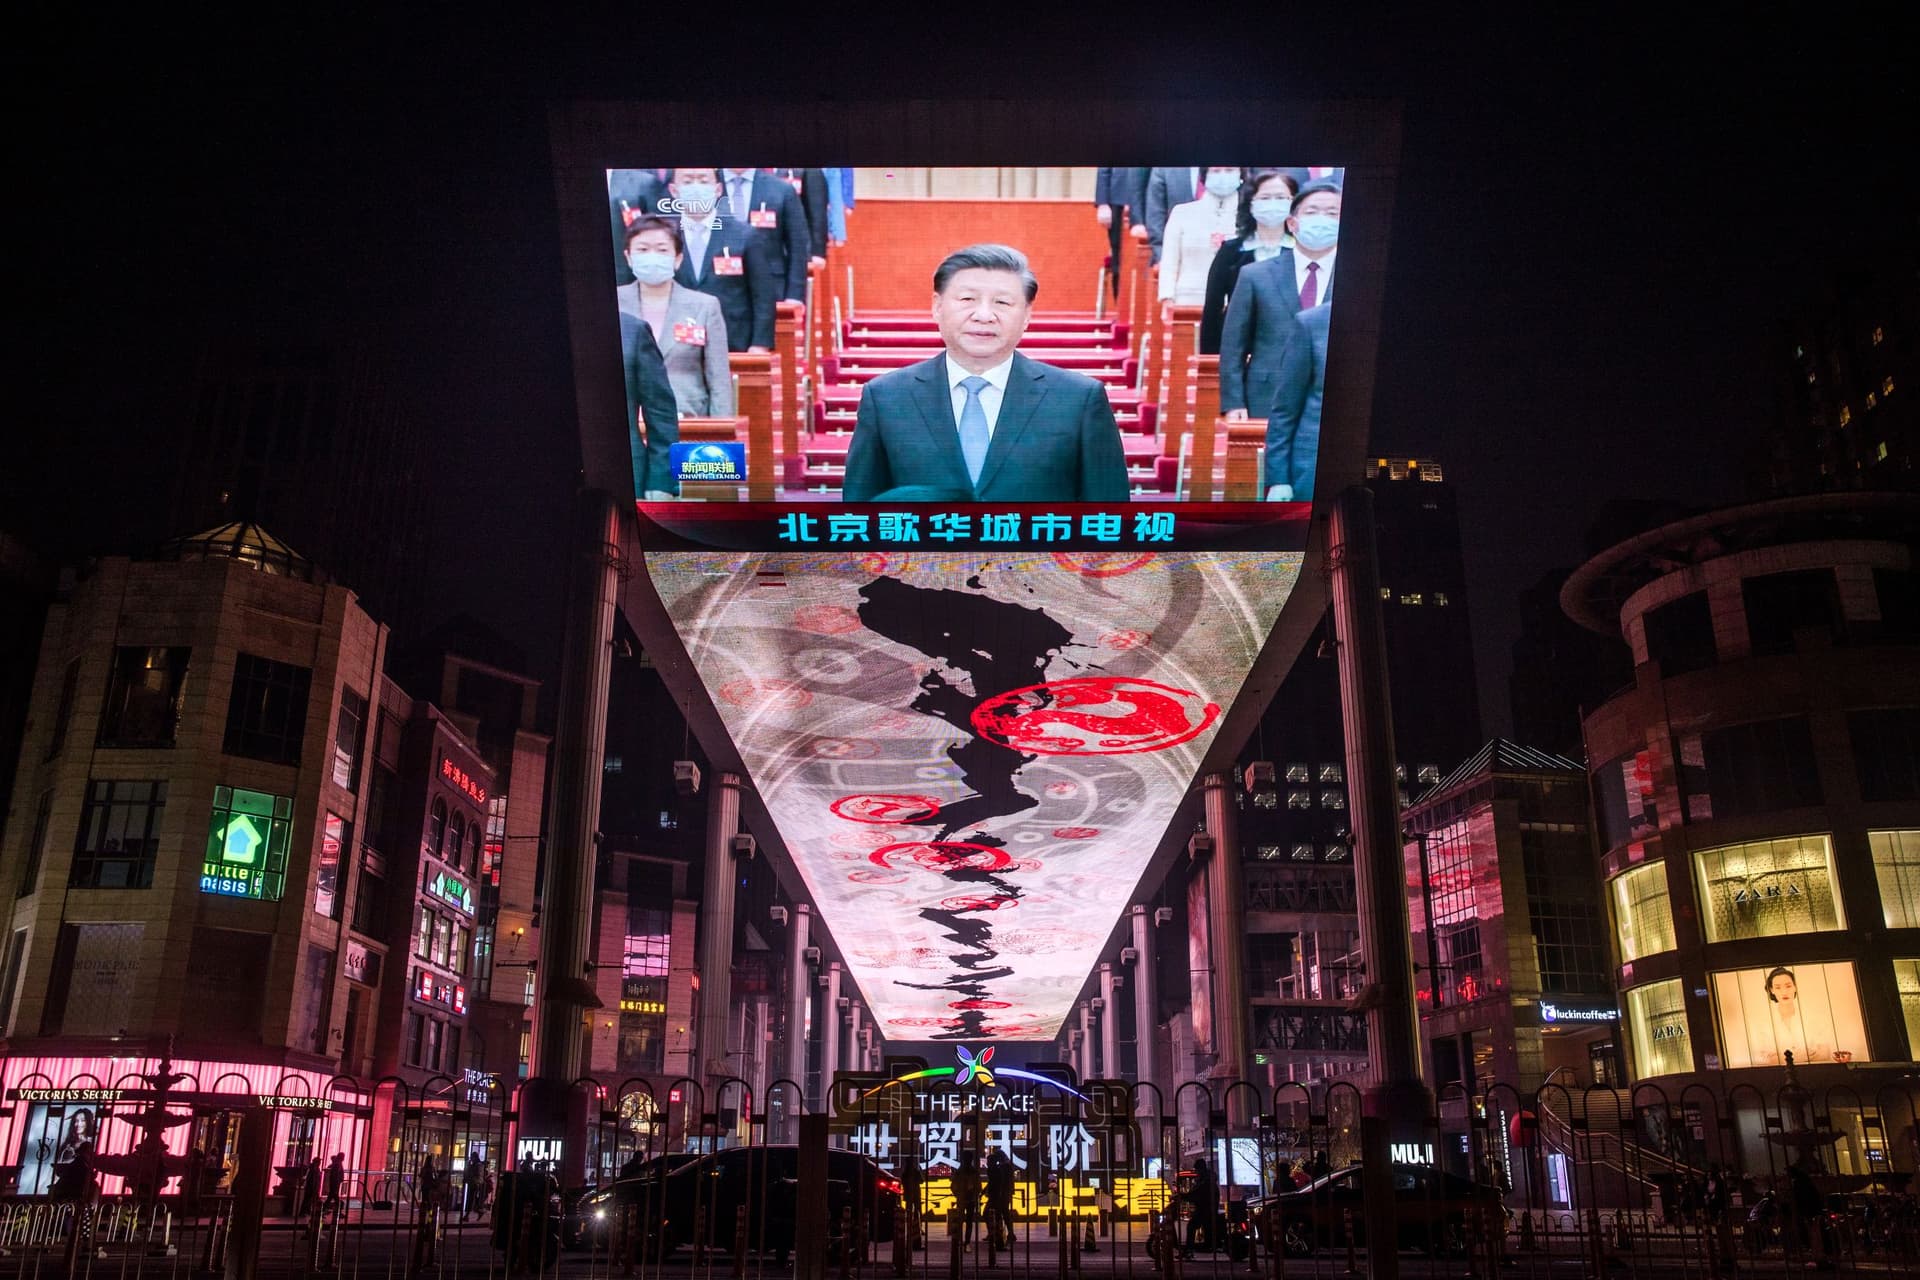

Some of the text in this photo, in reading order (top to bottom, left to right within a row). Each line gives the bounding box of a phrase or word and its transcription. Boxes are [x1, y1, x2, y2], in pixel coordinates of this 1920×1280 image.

[657, 198, 714, 213] CCTV
[681, 461, 735, 473] 新闻联播
[778, 512, 1175, 543] 北京歌华城市电视
[1735, 884, 1801, 902] ZARA
[1653, 1024, 1685, 1040] ZARA
[19, 1089, 79, 1100] VICTORIA'S
[259, 1095, 333, 1109] VICTORIA'S SERET
[916, 1094, 1034, 1112] THE PLACE
[518, 1140, 562, 1160] MUJI
[850, 1121, 1096, 1172] 世贸天阶
[1390, 1143, 1434, 1164] MUJI
